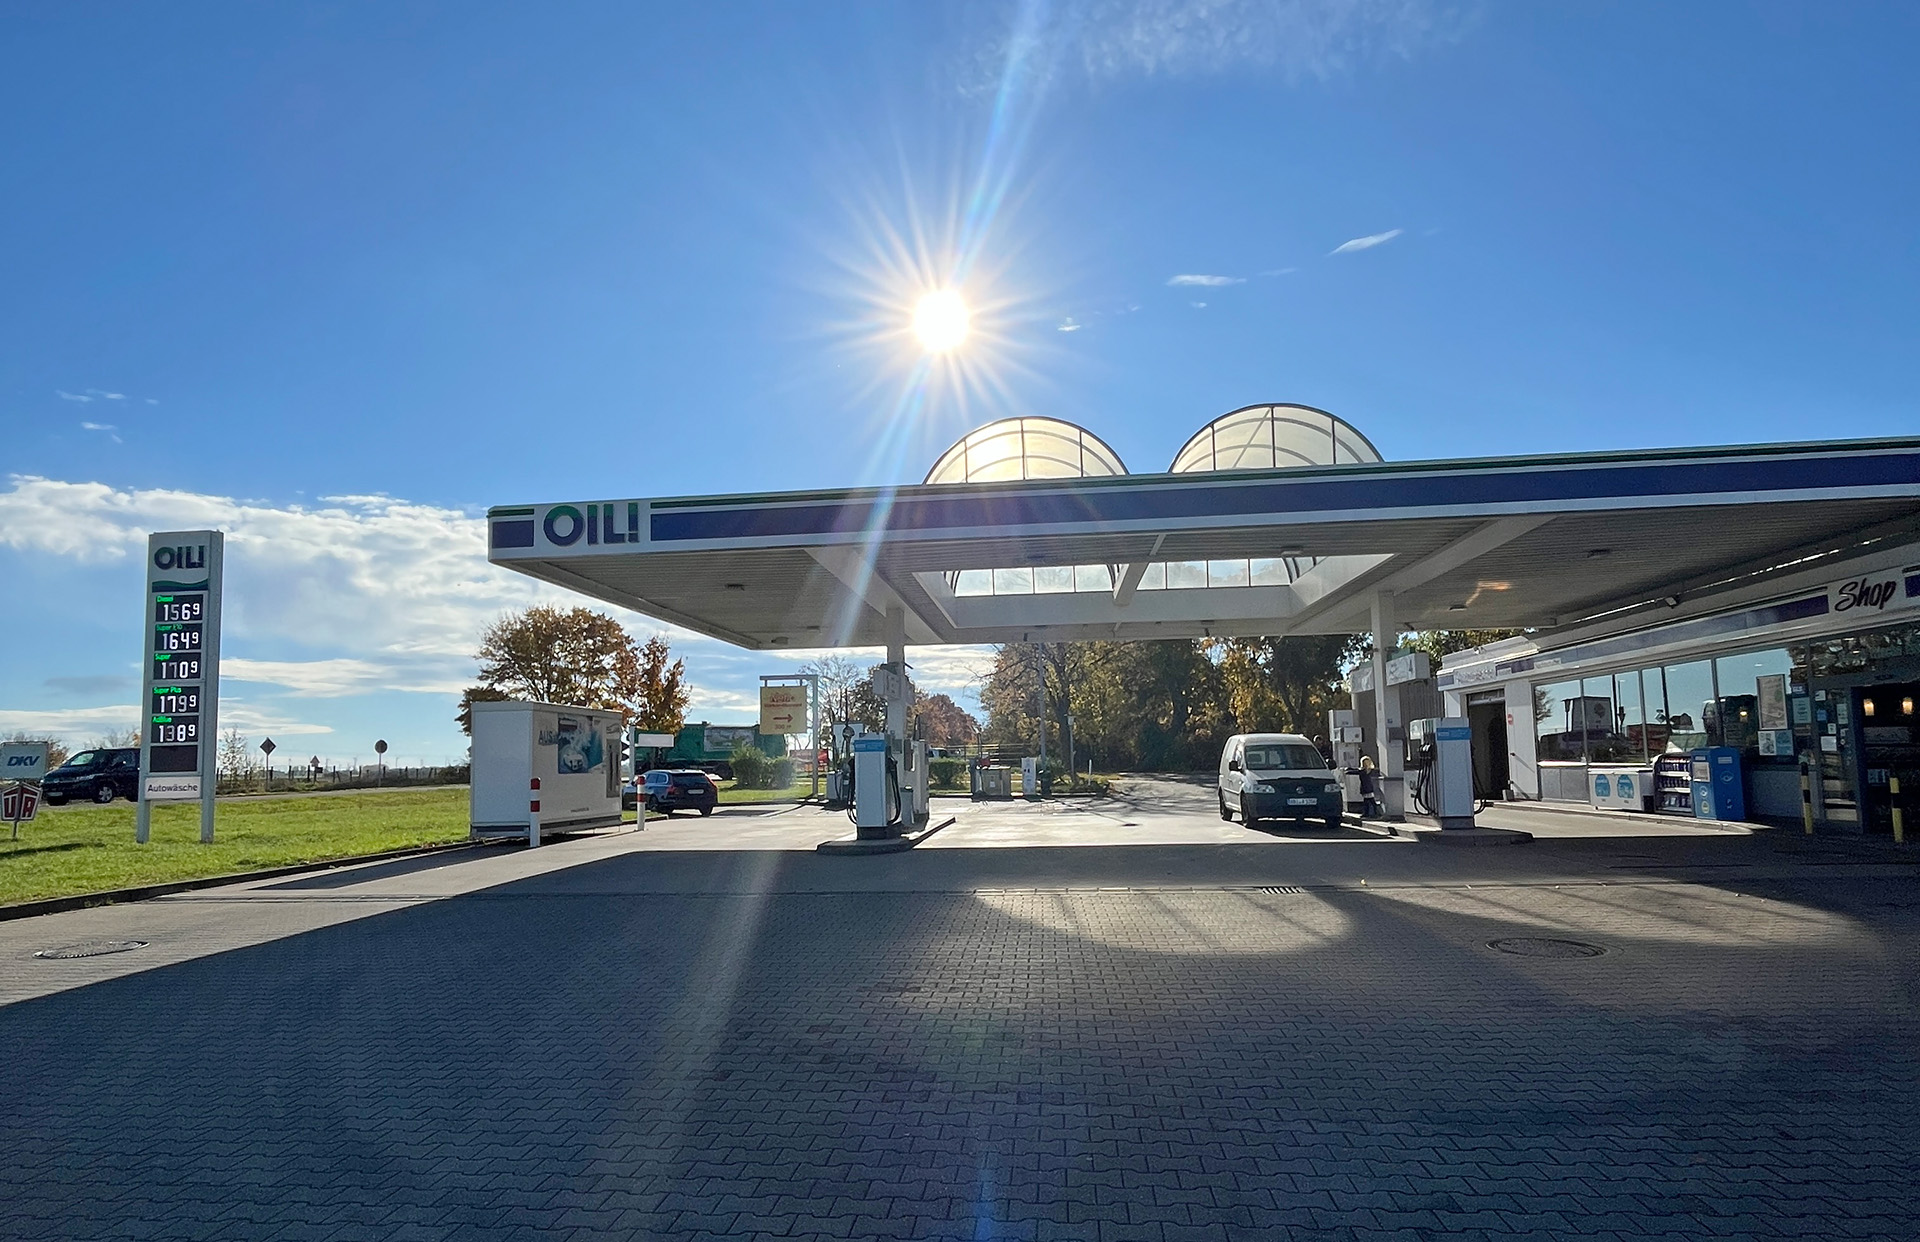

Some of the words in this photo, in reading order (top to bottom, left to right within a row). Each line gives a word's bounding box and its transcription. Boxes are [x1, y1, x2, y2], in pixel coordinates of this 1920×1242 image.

[543, 502, 639, 546] OIL!
[1834, 577, 1897, 612] Shop
[163, 603, 200, 621] 1569
[162, 632, 199, 650] 1649
[154, 653, 171, 661] Super
[161, 661, 198, 679] 1709
[153, 686, 169, 694] Super
[160, 695, 197, 713] 1799
[159, 724, 196, 742] 1389
[7, 756, 40, 767] DKV
[147, 783, 198, 792] Autowäsche
